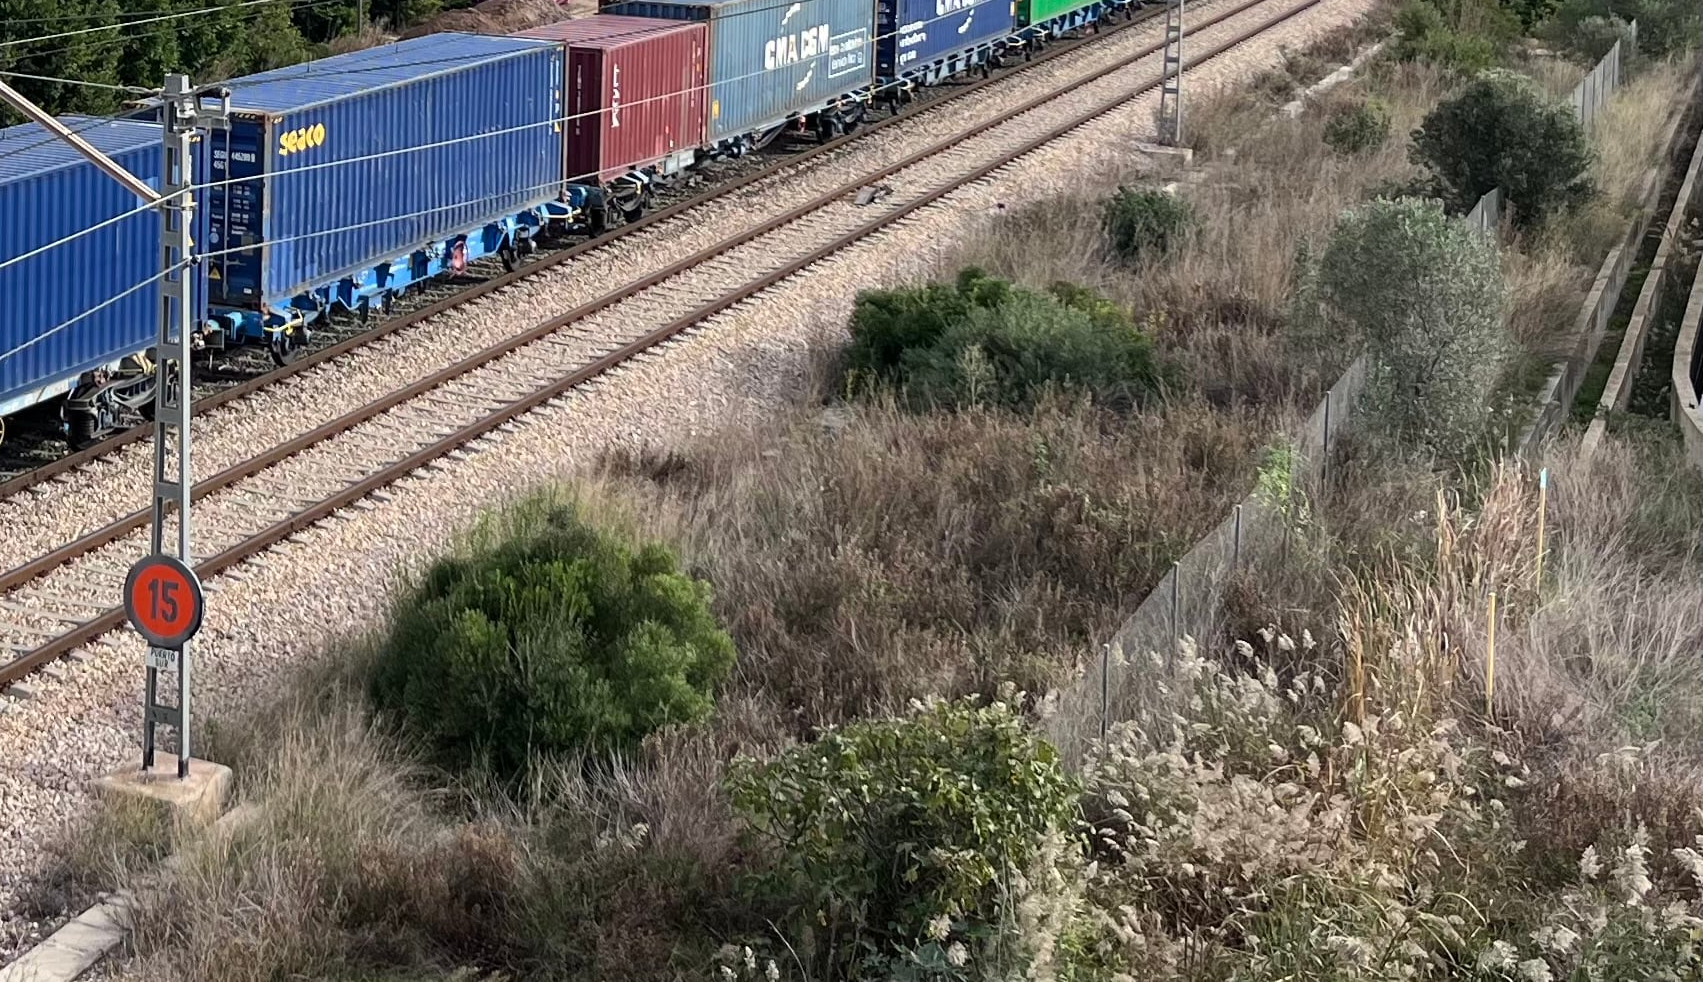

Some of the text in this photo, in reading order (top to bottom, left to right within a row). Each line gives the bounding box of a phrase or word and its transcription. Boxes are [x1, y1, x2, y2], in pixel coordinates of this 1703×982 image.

[764, 34, 798, 70] CMA
[278, 122, 325, 156] seaco
[148, 578, 179, 622] 15
